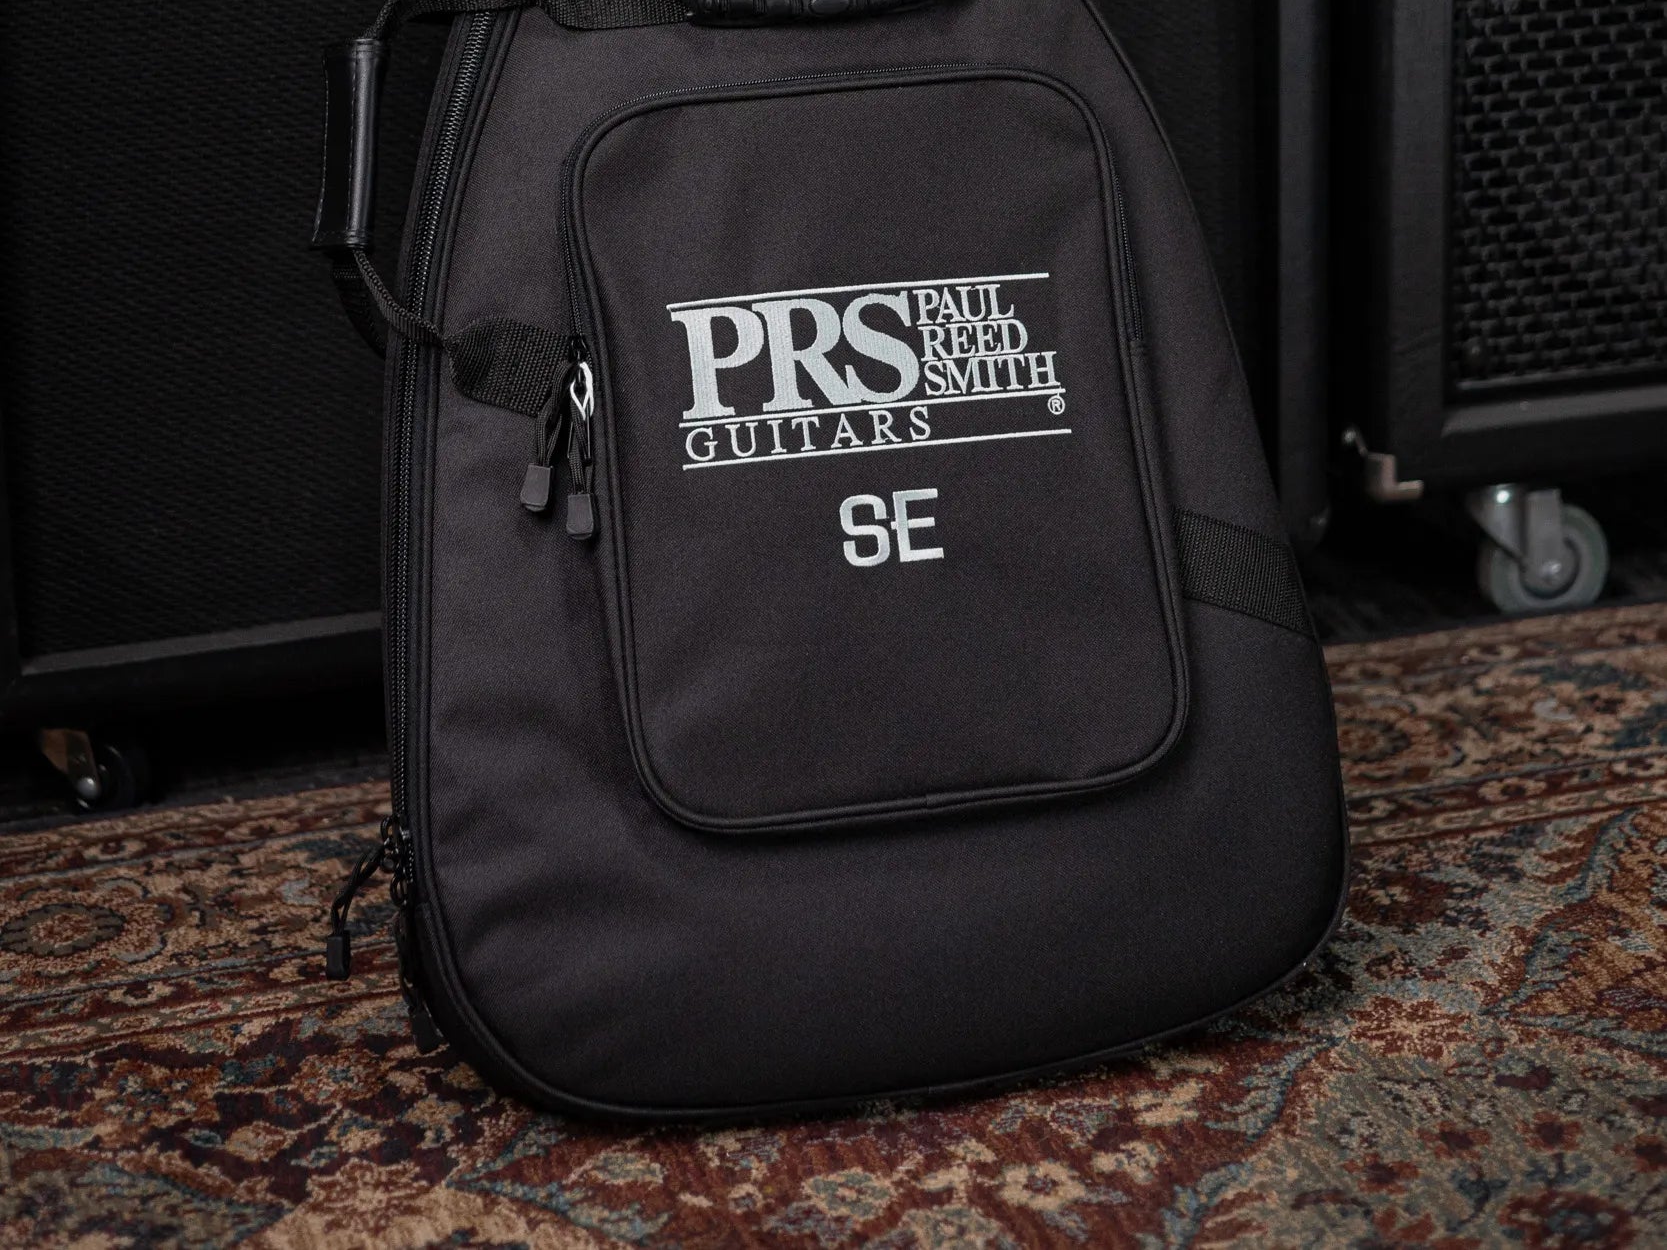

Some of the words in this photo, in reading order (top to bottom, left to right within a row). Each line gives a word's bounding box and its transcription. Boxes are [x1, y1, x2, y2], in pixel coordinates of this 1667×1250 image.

[913, 284, 1015, 325] PAUL
[671, 291, 920, 420] PRS
[919, 318, 1028, 362] REED
[924, 350, 1062, 396] SMITH
[685, 406, 933, 462] GUITARS
[839, 488, 944, 568] SE
